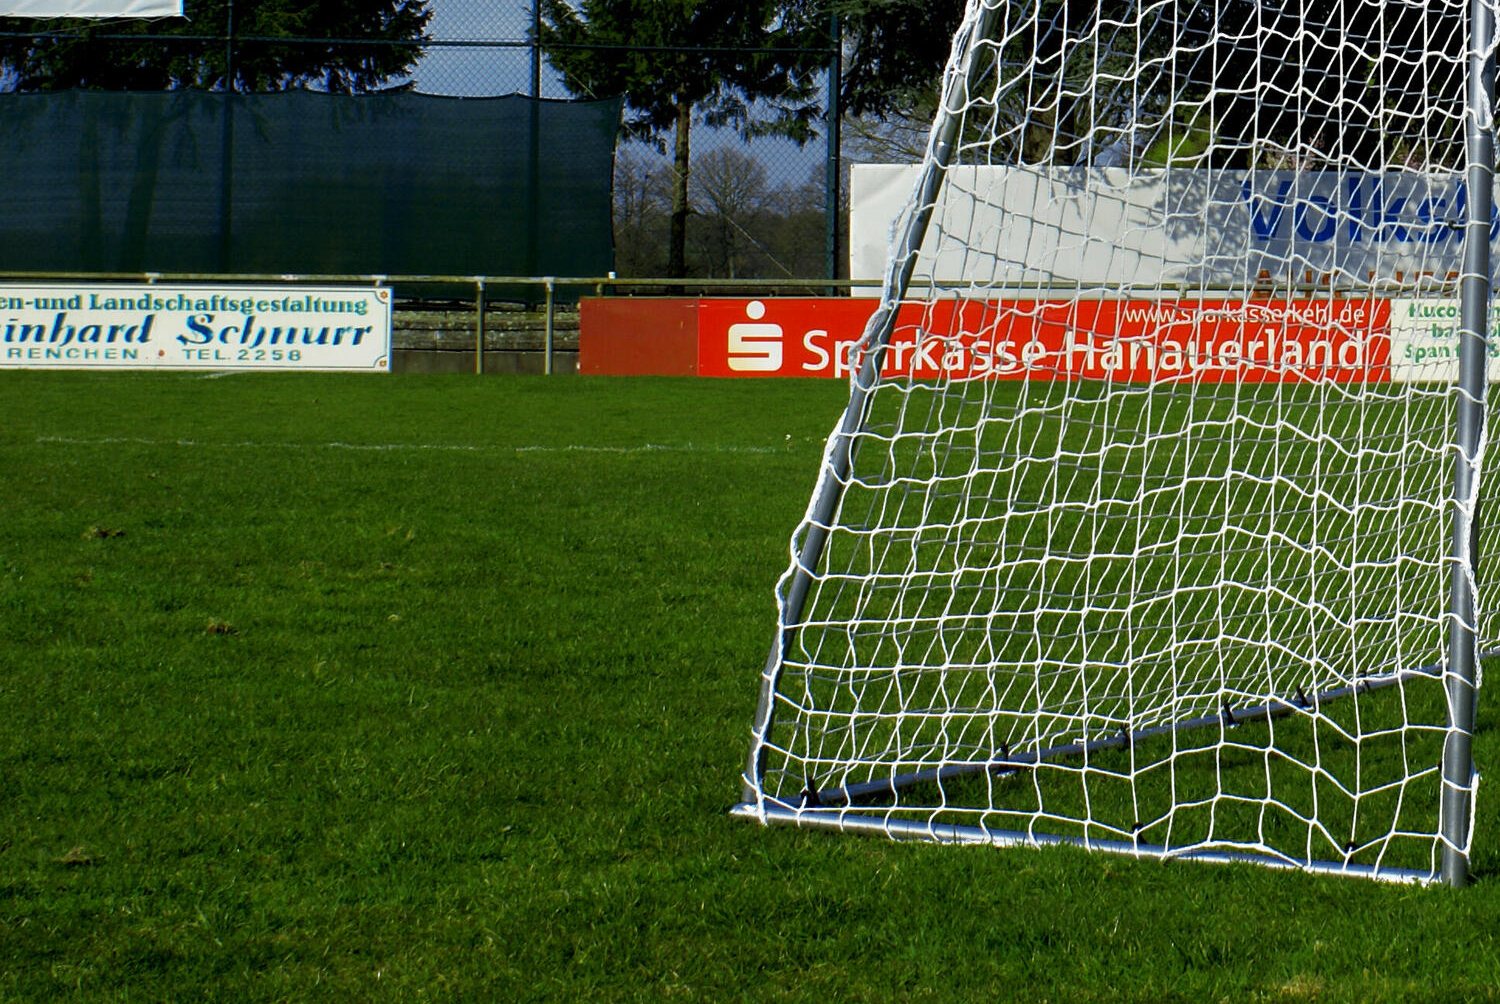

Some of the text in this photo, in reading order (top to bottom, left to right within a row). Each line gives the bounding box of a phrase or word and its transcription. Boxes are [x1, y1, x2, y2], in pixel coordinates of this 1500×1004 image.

[89, 293, 369, 316] Landschaftsgestaltung
[0, 311, 373, 349] inhard Schnurr
[7, 347, 139, 360] RENCHEN
[801, 328, 1364, 378] Sprkasse Hanauerland
[1404, 343, 1451, 363] Span
